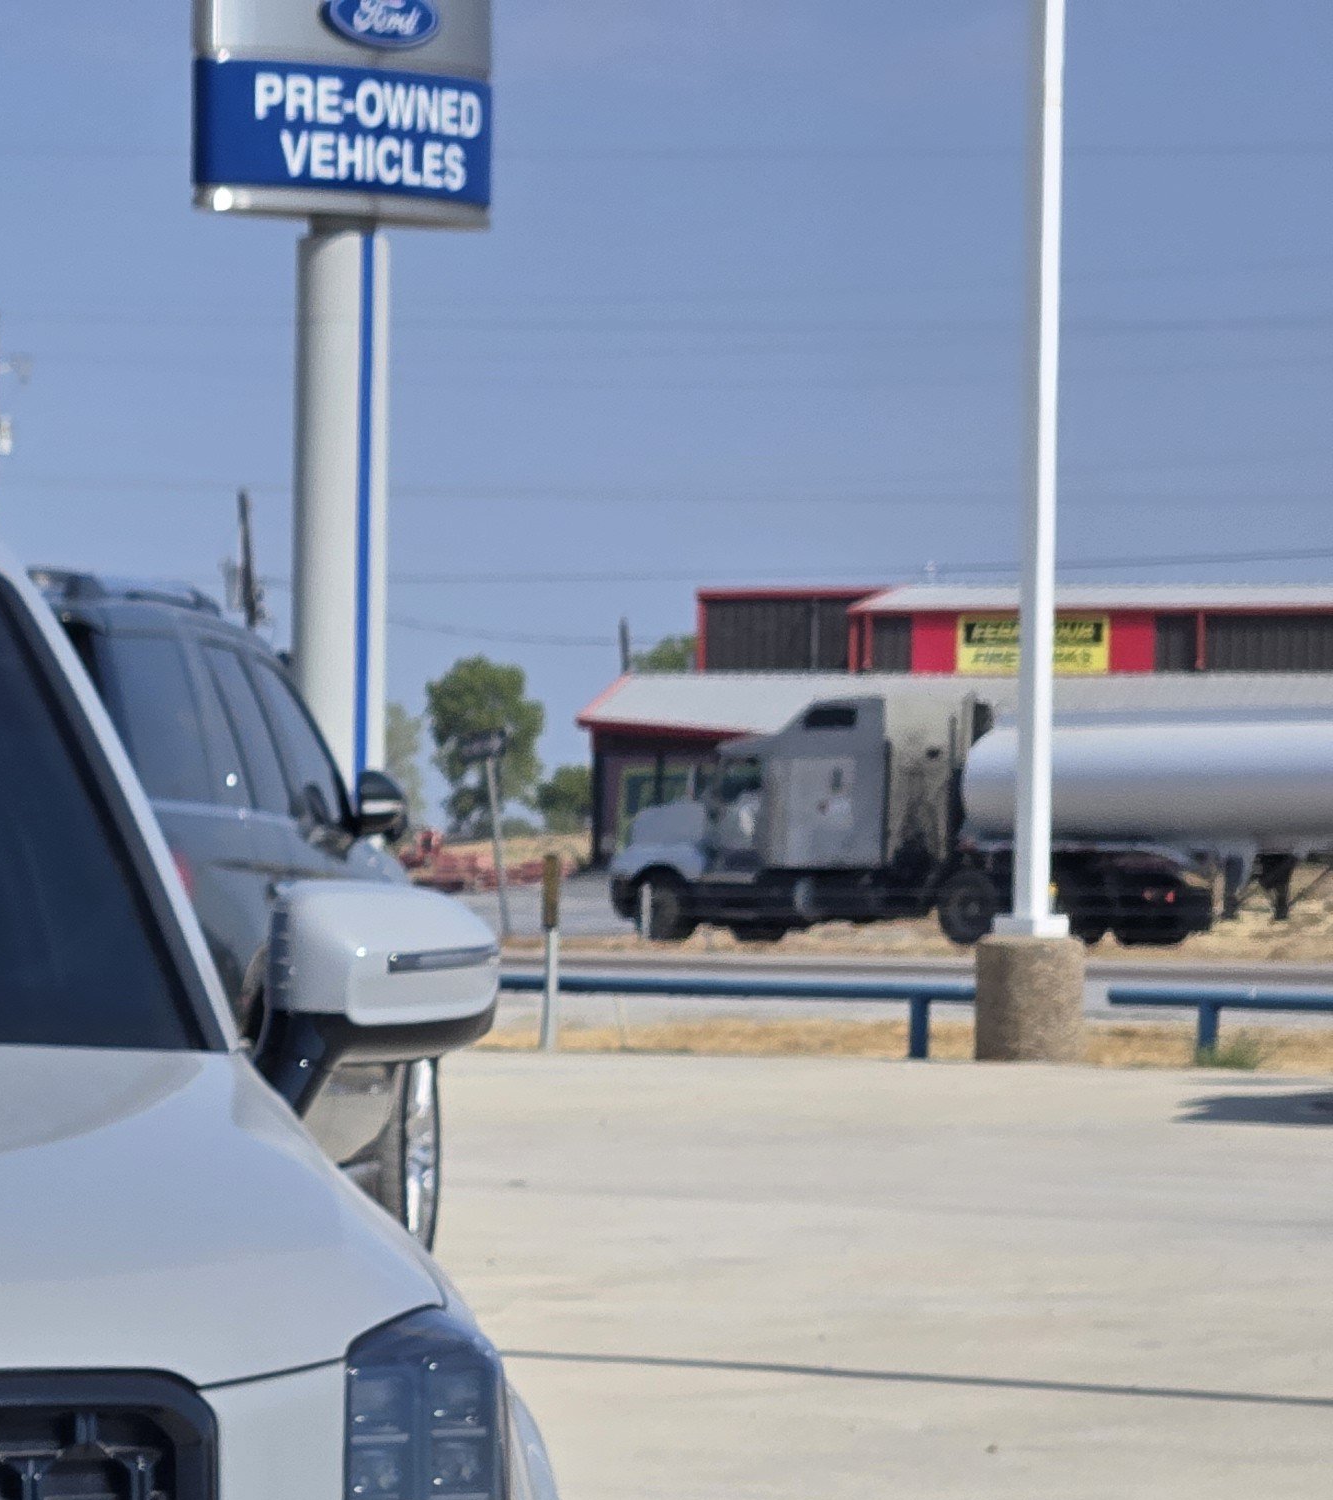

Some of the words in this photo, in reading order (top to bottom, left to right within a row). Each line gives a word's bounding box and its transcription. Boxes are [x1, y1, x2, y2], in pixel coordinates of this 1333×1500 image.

[353, 0, 421, 36] Ford
[254, 72, 482, 139] PRE-OWNED
[279, 129, 467, 191] VEHICLES
